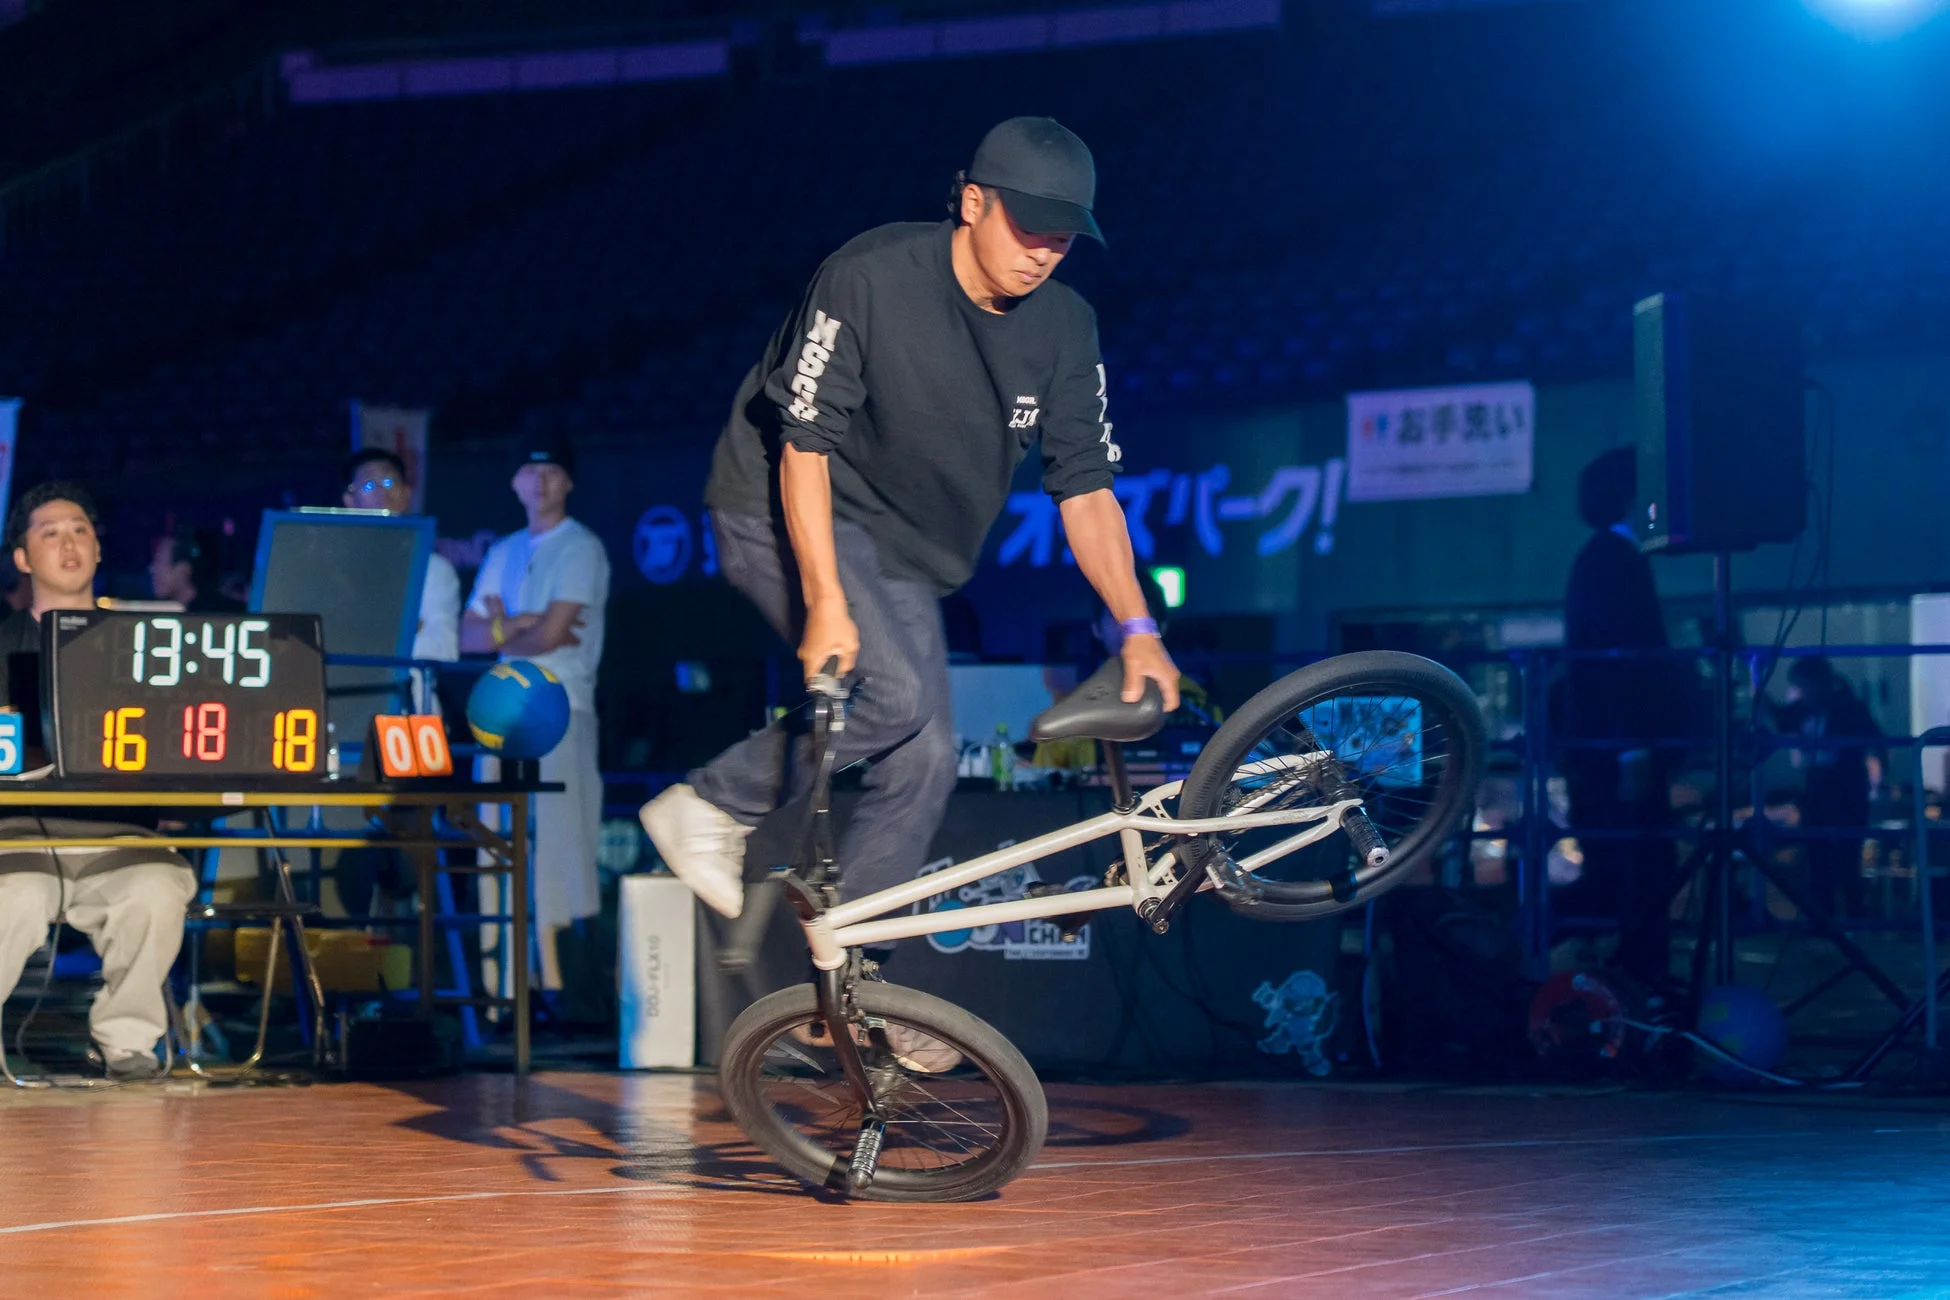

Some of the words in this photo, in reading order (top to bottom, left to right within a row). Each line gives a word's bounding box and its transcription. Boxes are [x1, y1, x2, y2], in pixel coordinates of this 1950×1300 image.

[133, 618, 271, 688] 13:45
[102, 707, 148, 772] 16
[183, 702, 227, 761] 18
[272, 709, 317, 772] 18
